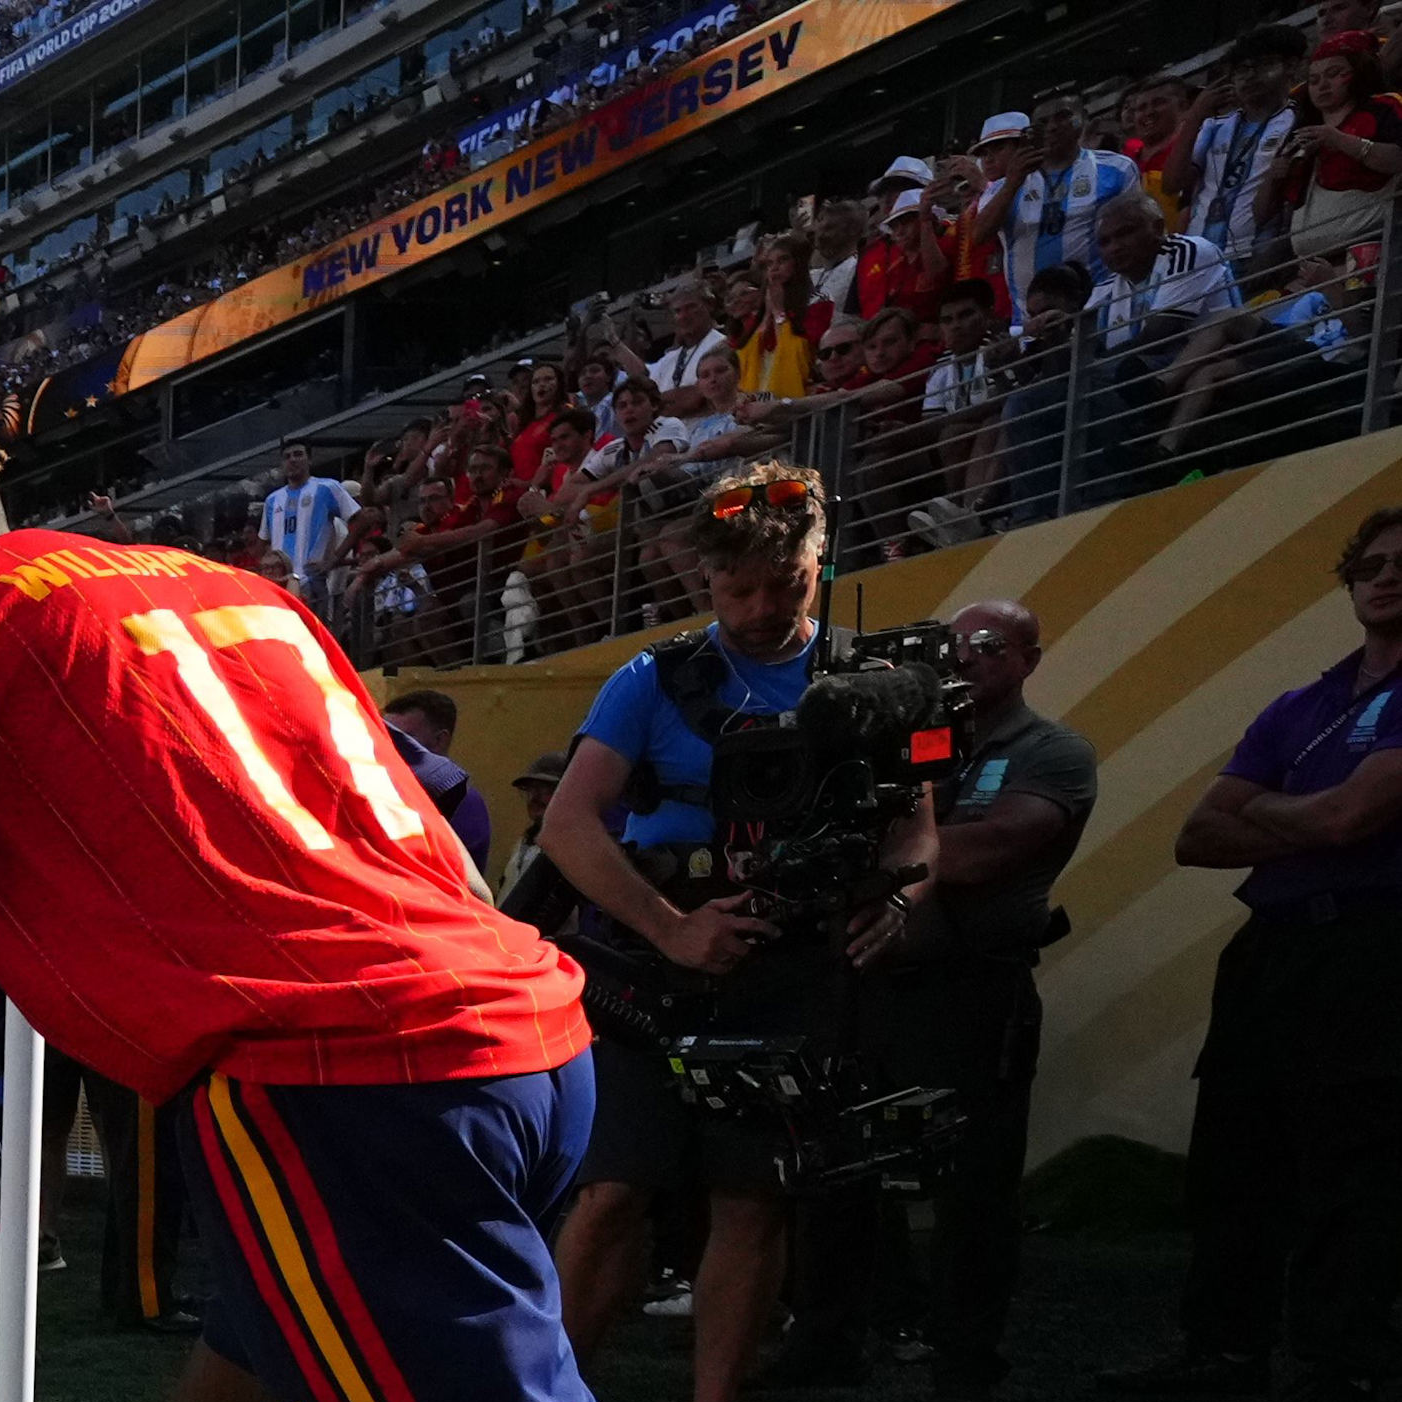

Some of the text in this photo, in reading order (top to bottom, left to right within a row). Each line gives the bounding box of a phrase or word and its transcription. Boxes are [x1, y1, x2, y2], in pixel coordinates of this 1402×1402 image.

[0, 0, 140, 84] FIFA WORLD CUP 202
[302, 234, 381, 298] NEW
[391, 178, 495, 256] YORK
[505, 126, 599, 204] NEW
[609, 21, 802, 150] JERSEY
[284, 515, 296, 535] 10
[120, 604, 425, 850] 17
